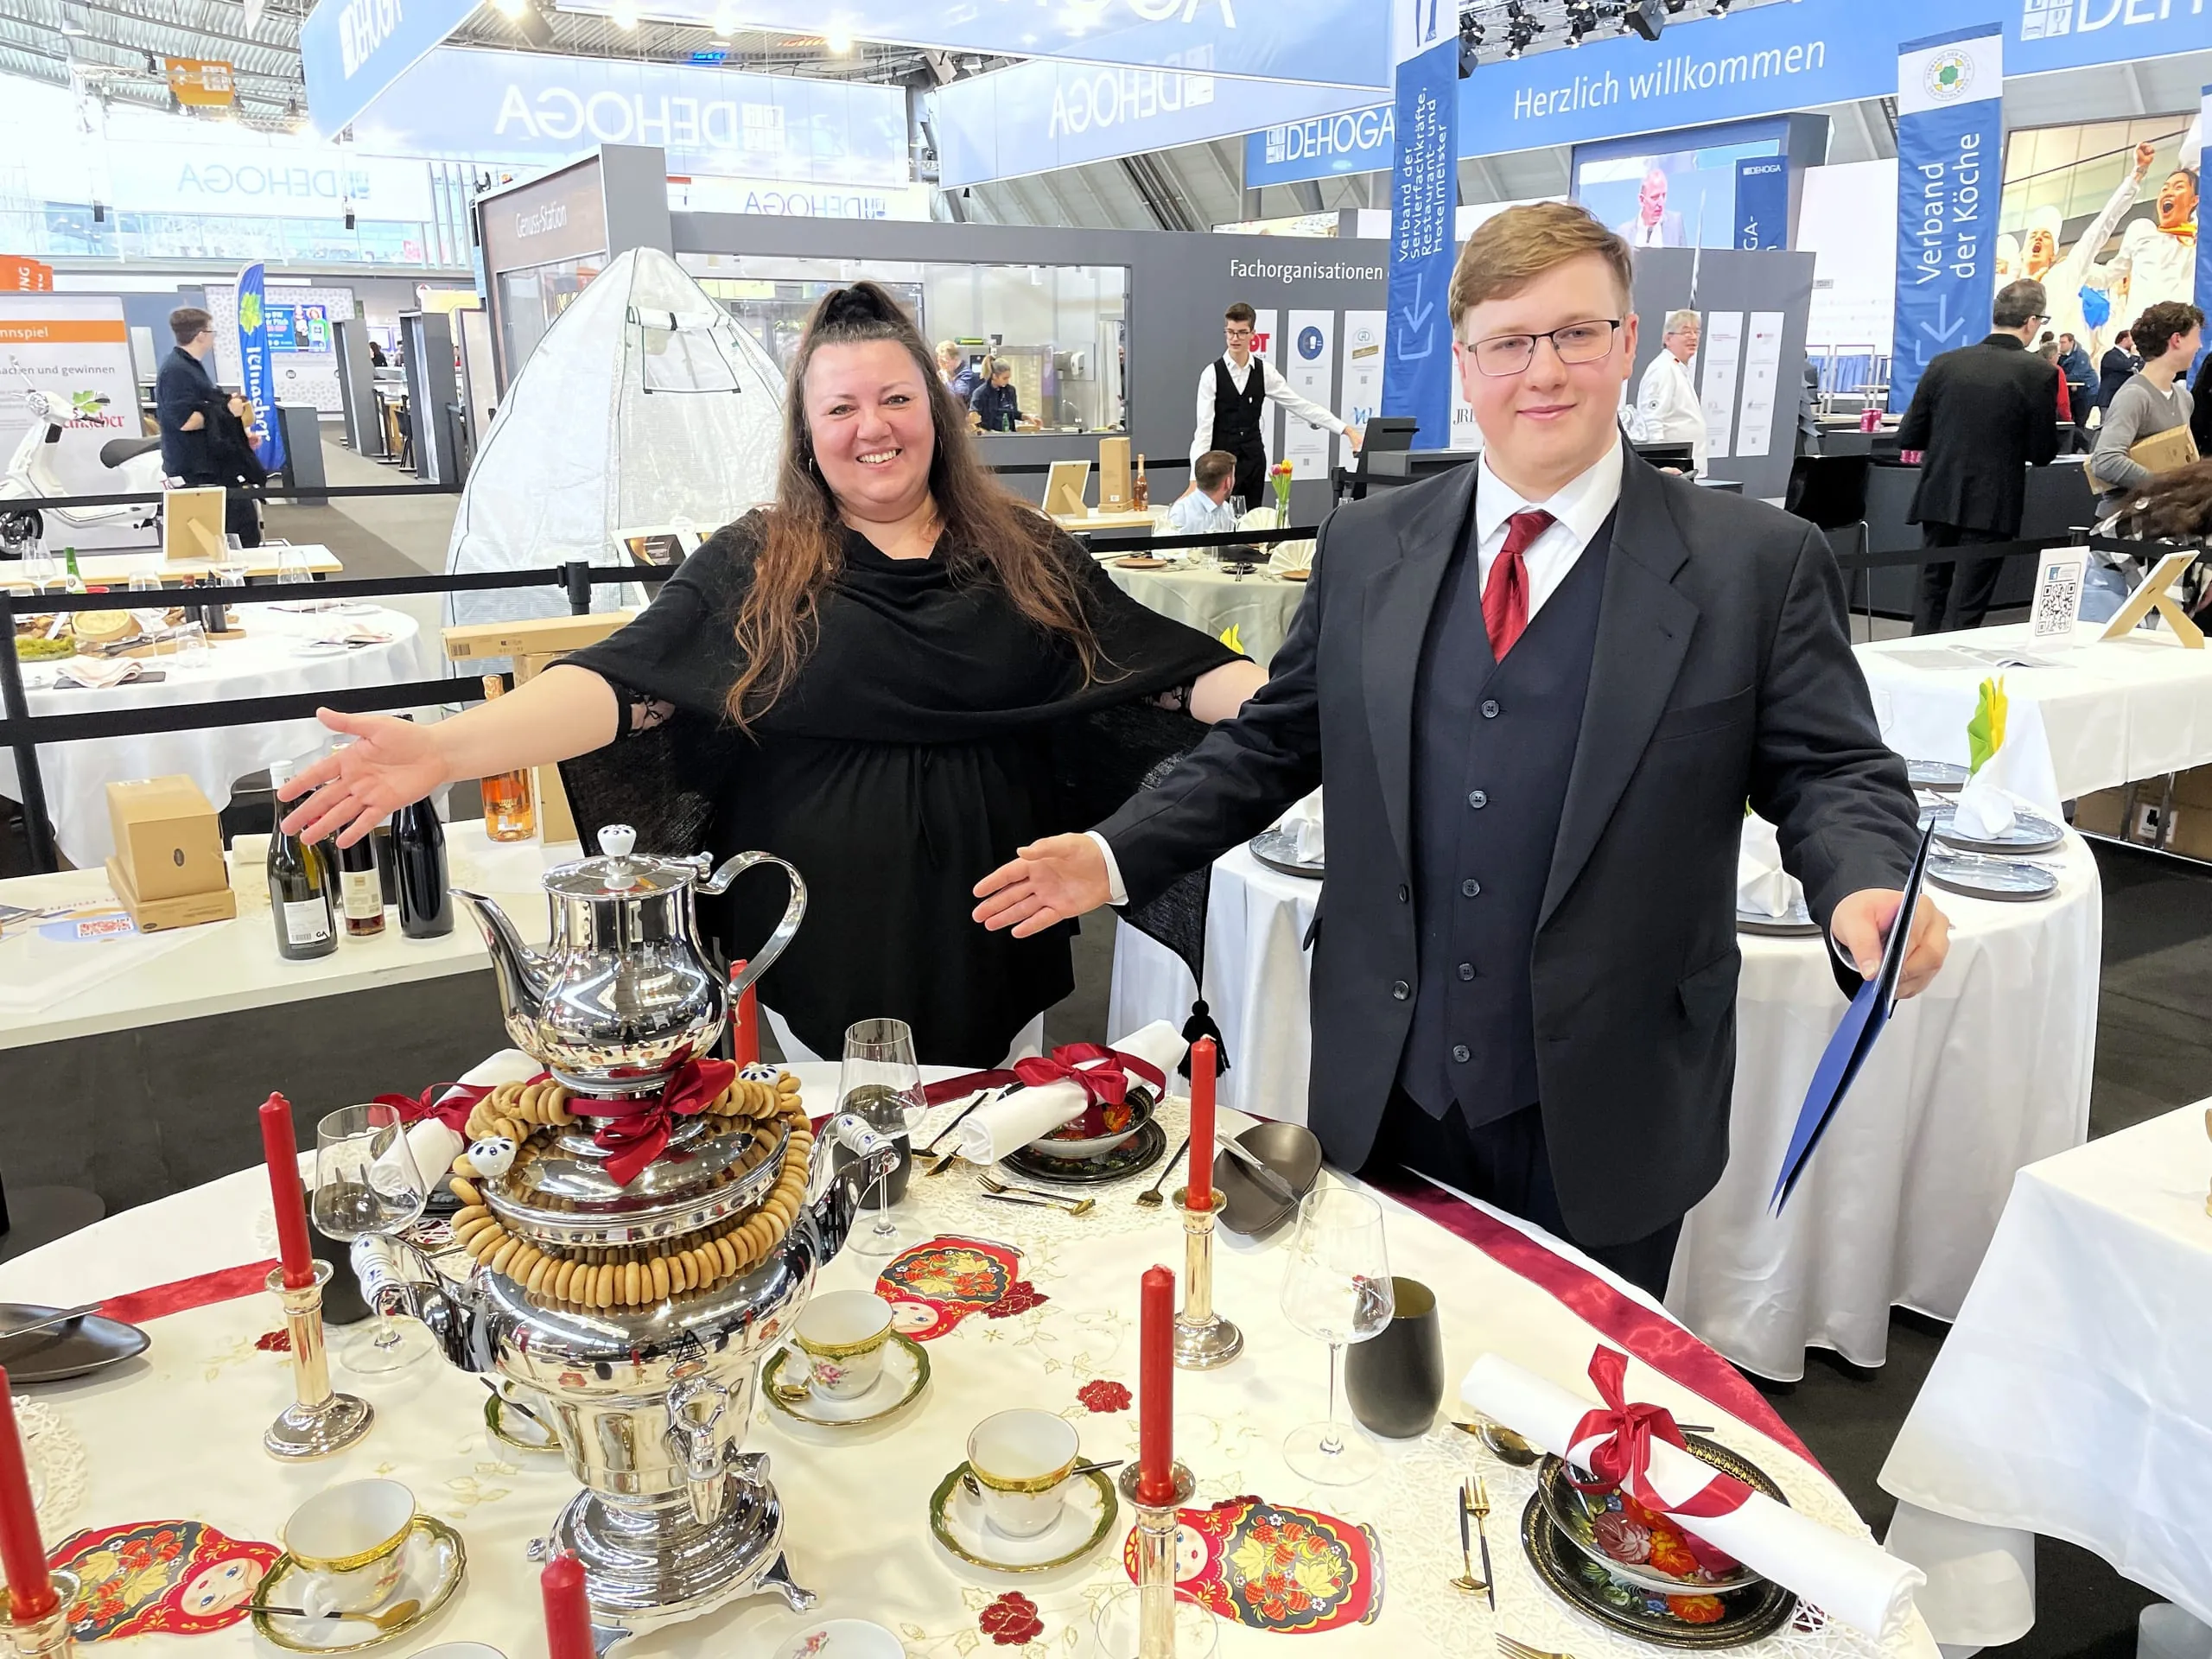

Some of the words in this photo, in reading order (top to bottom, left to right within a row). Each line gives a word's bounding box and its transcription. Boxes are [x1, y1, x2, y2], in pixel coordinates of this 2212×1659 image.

[1427, 99, 1437, 137] und
[1514, 70, 1619, 120] Herzlich
[1629, 40, 1826, 100] willkommen
[1287, 107, 1395, 161] DEHOGA
[1402, 147, 1413, 177] der
[1410, 87, 1427, 259] Servierfachkräfte,
[1421, 143, 1436, 257] Restaurant-
[1433, 124, 1447, 252] Hotelmeister
[1951, 132, 1980, 223] Köche
[1399, 183, 1413, 262] Verband
[1916, 162, 1944, 285] Verband
[1949, 232, 1977, 279] der
[1230, 258, 1383, 283] Fachorganisationen
[37, 365, 59, 375] und
[61, 364, 116, 377] gewinnen
